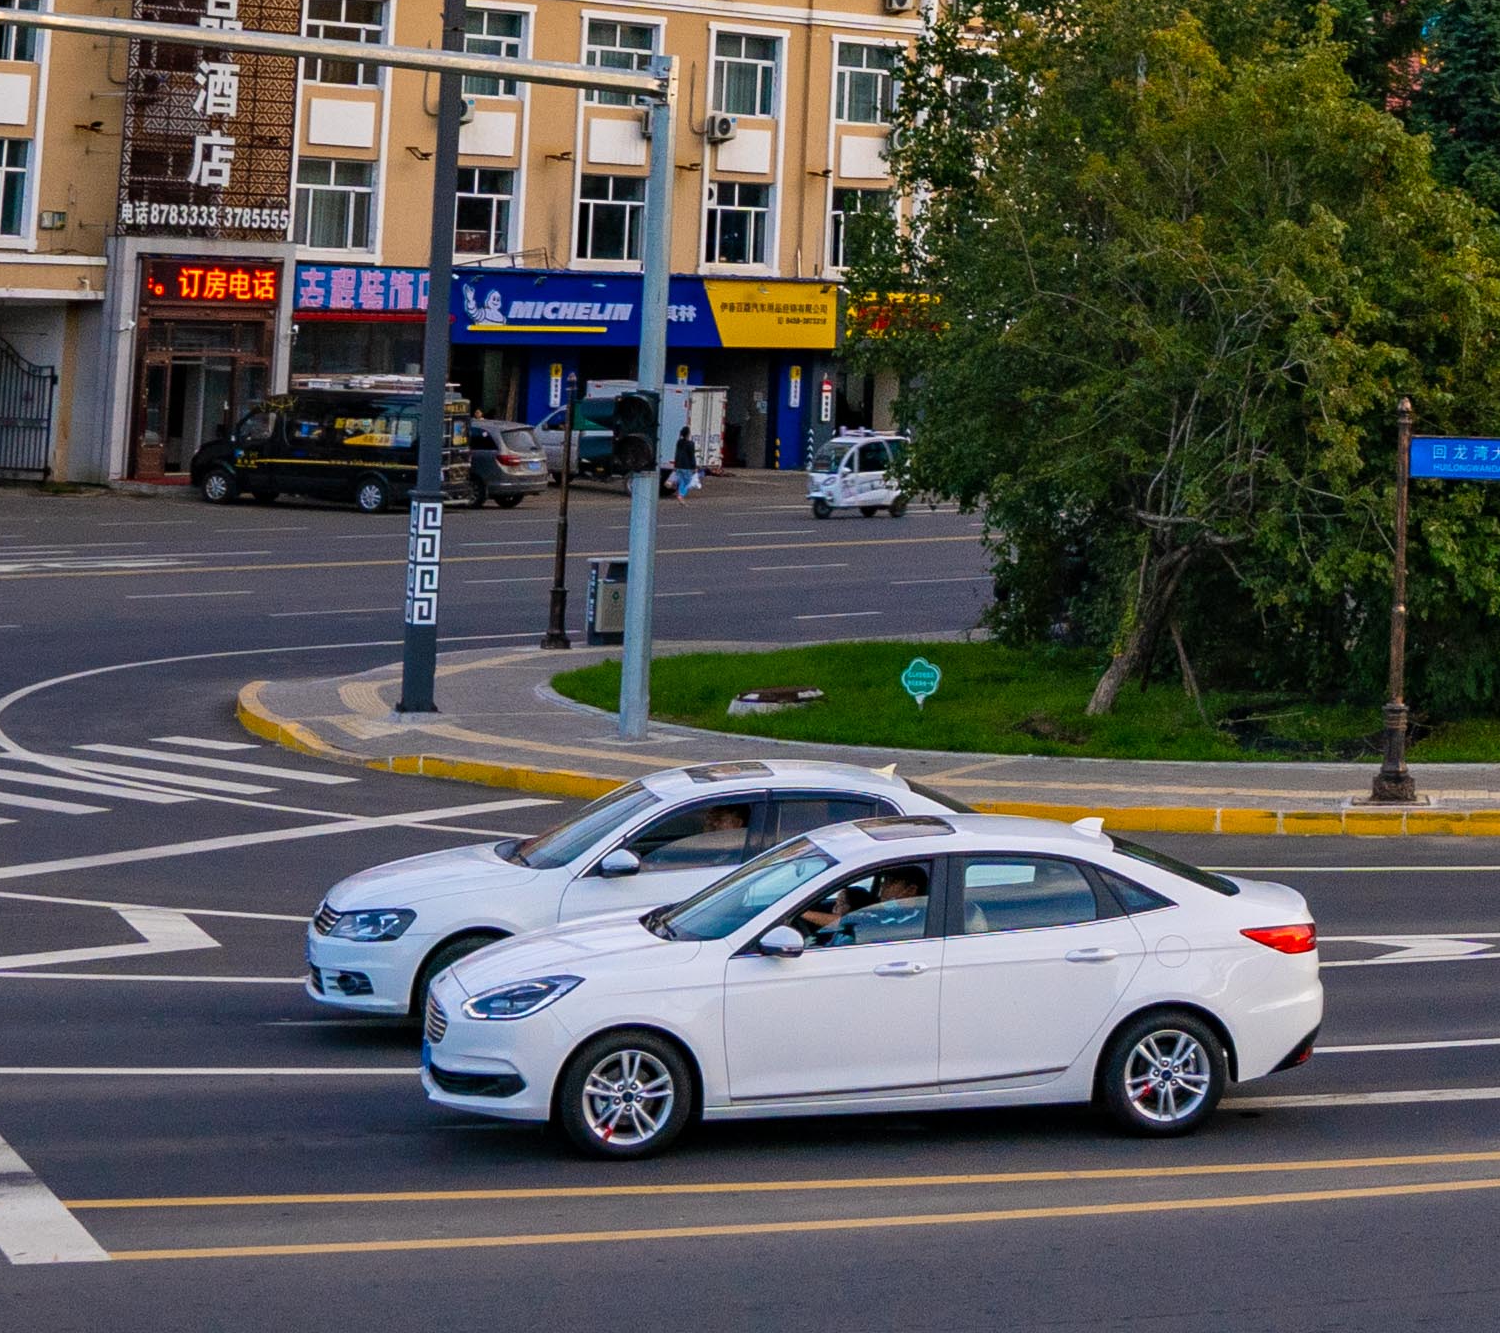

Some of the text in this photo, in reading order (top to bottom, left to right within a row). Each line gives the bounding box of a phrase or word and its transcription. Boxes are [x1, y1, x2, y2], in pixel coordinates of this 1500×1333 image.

[224, 208, 290, 230] 3785555
[178, 267, 277, 301] 订房电话
[508, 300, 633, 322] MICHELIN
[666, 304, 698, 324] 其林
